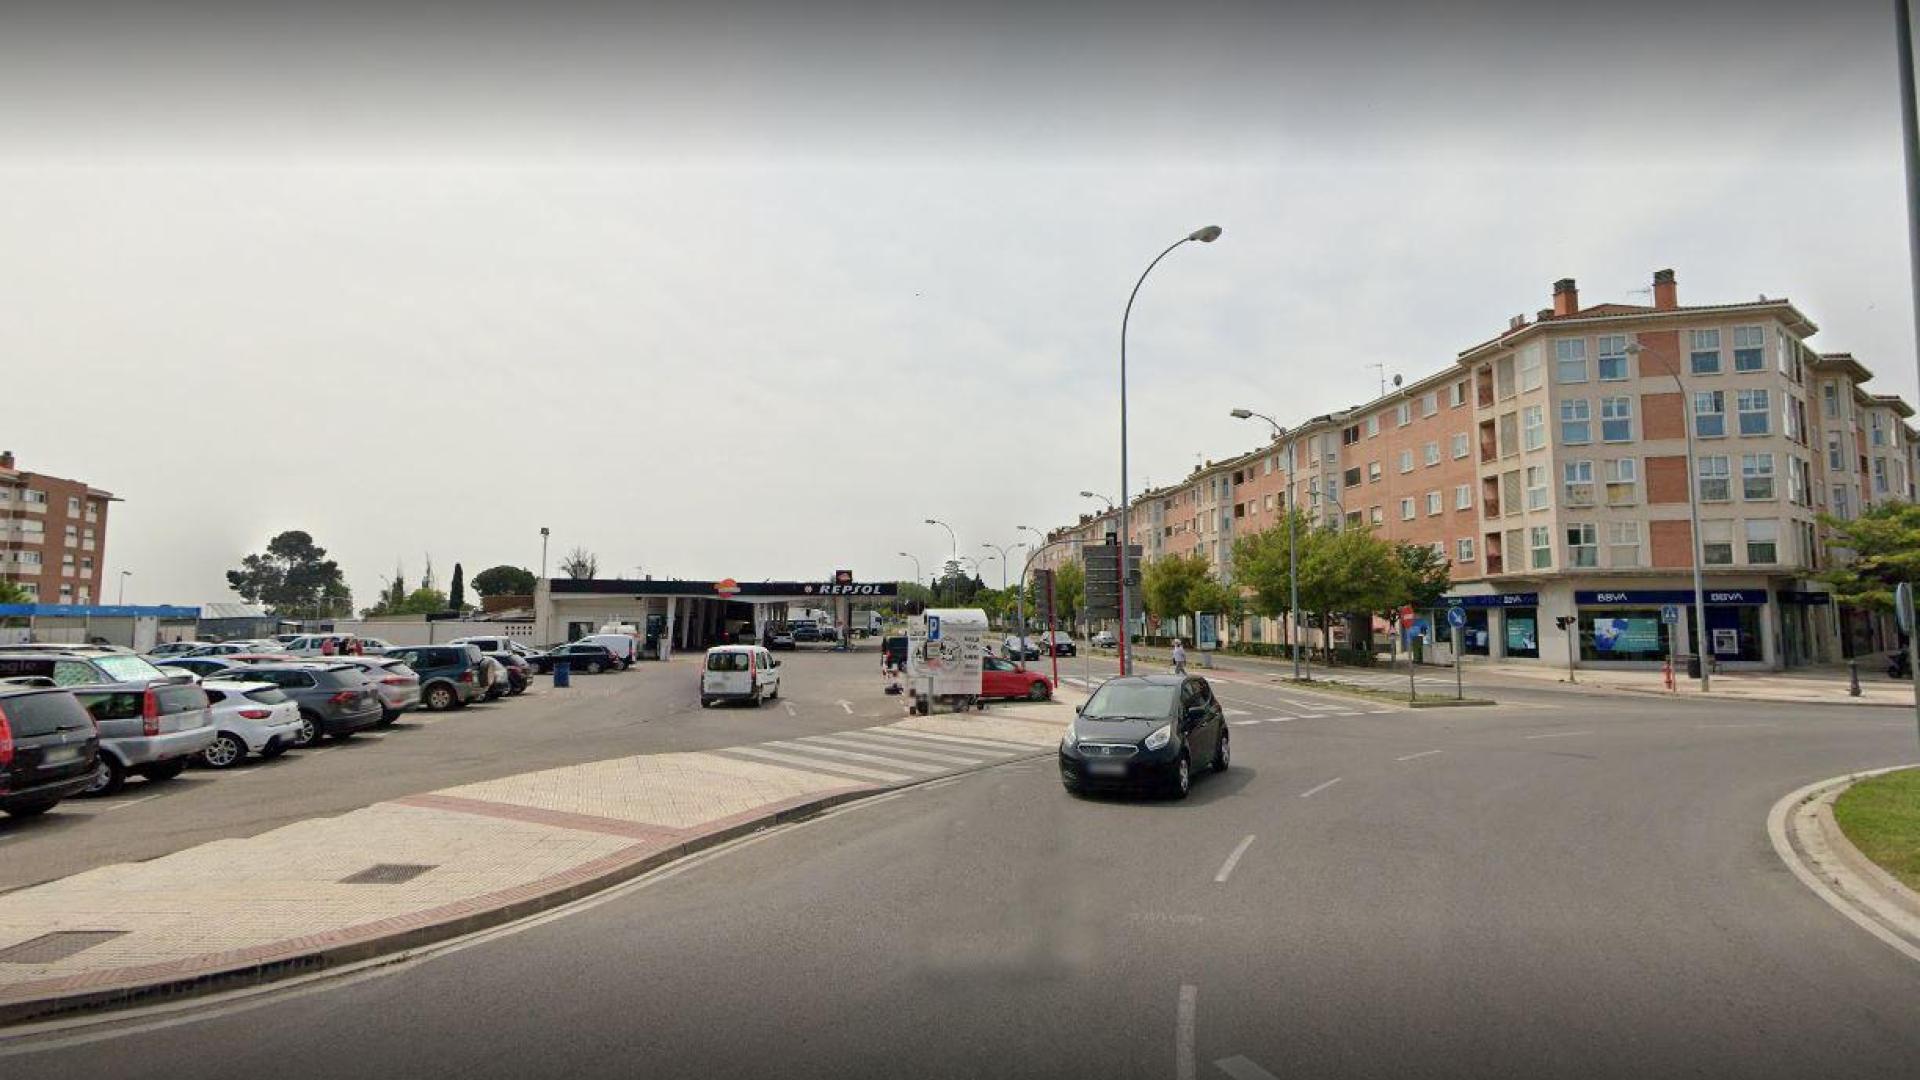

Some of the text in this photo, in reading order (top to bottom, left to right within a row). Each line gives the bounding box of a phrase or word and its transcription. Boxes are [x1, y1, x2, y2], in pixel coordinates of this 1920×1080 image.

[819, 584, 881, 595] REPSOL
[1597, 592, 1628, 602] BBVA
[1710, 592, 1743, 602] BBVA
[930, 618, 937, 637] P
